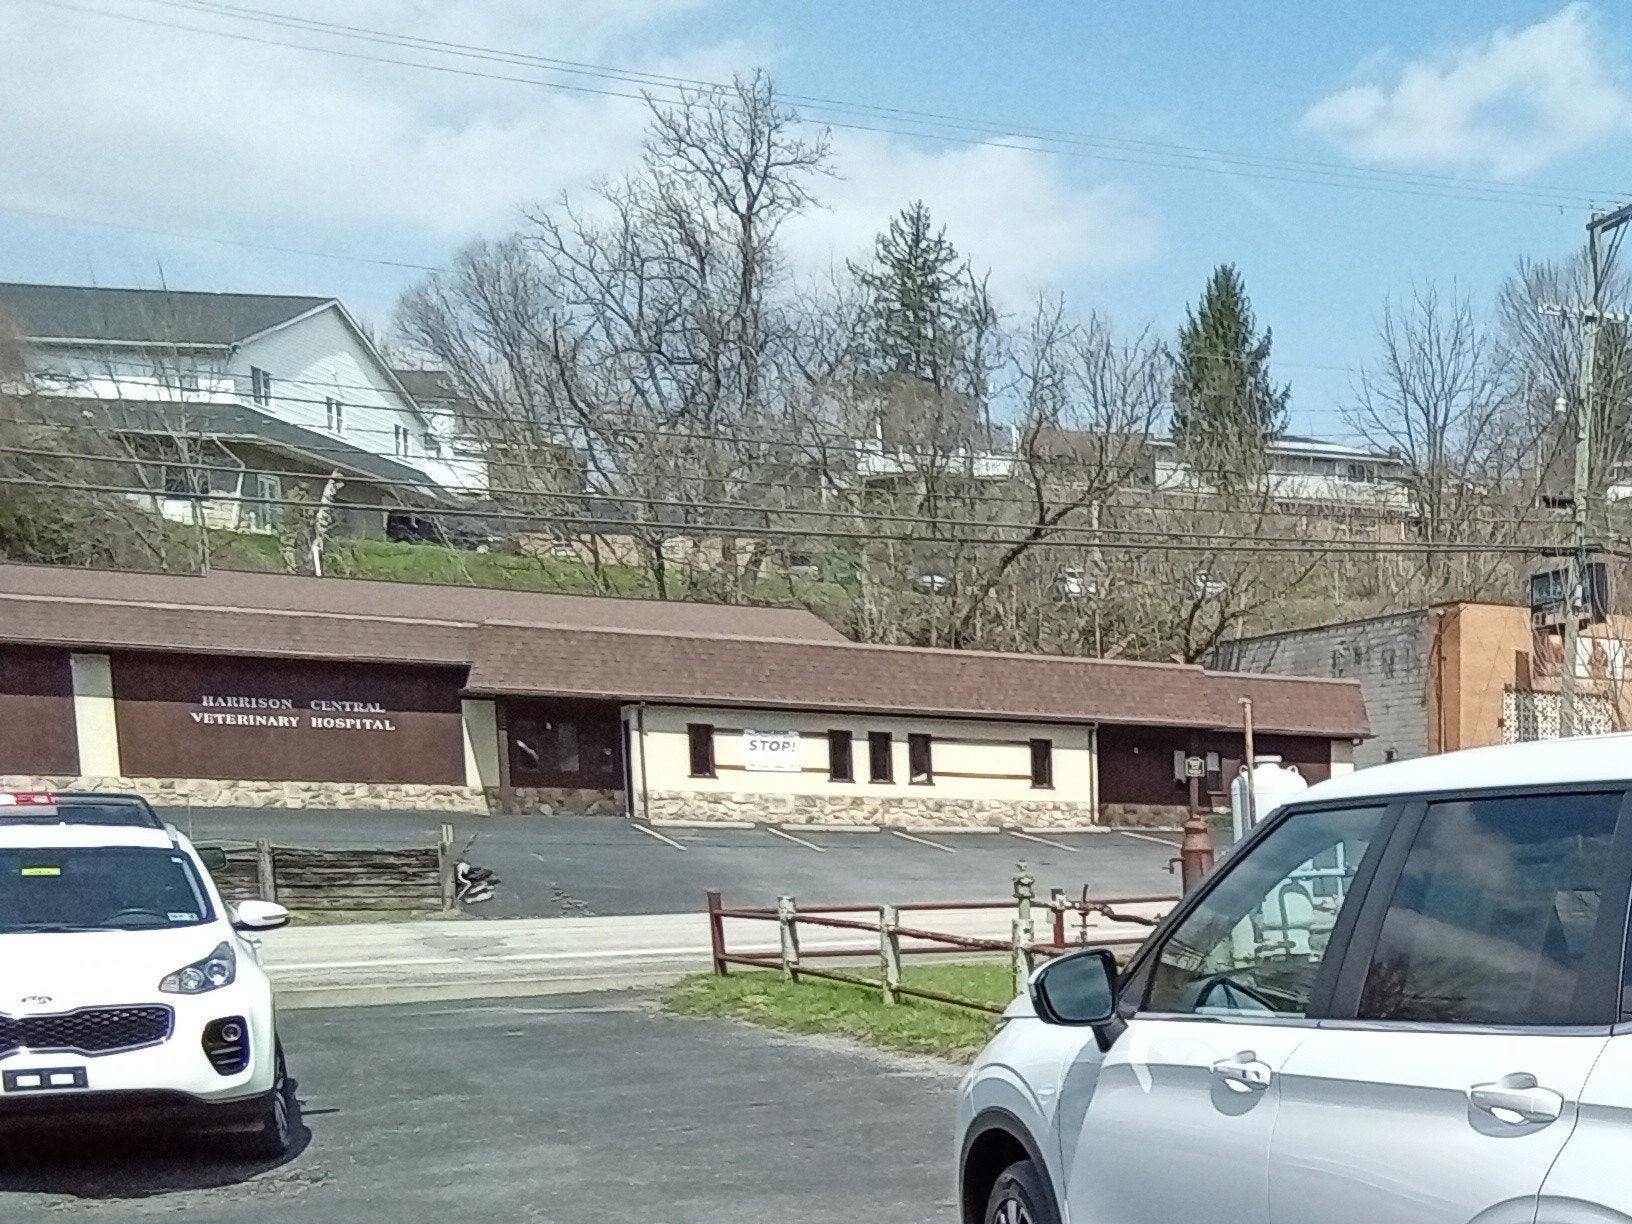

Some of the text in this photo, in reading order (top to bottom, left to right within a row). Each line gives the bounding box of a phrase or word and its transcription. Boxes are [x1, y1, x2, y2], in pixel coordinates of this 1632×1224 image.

[201, 695, 386, 713] HARRISON CENTRAL
[190, 712, 396, 731] VETERINARY HOSPITAL
[749, 740, 796, 752] STOP!
